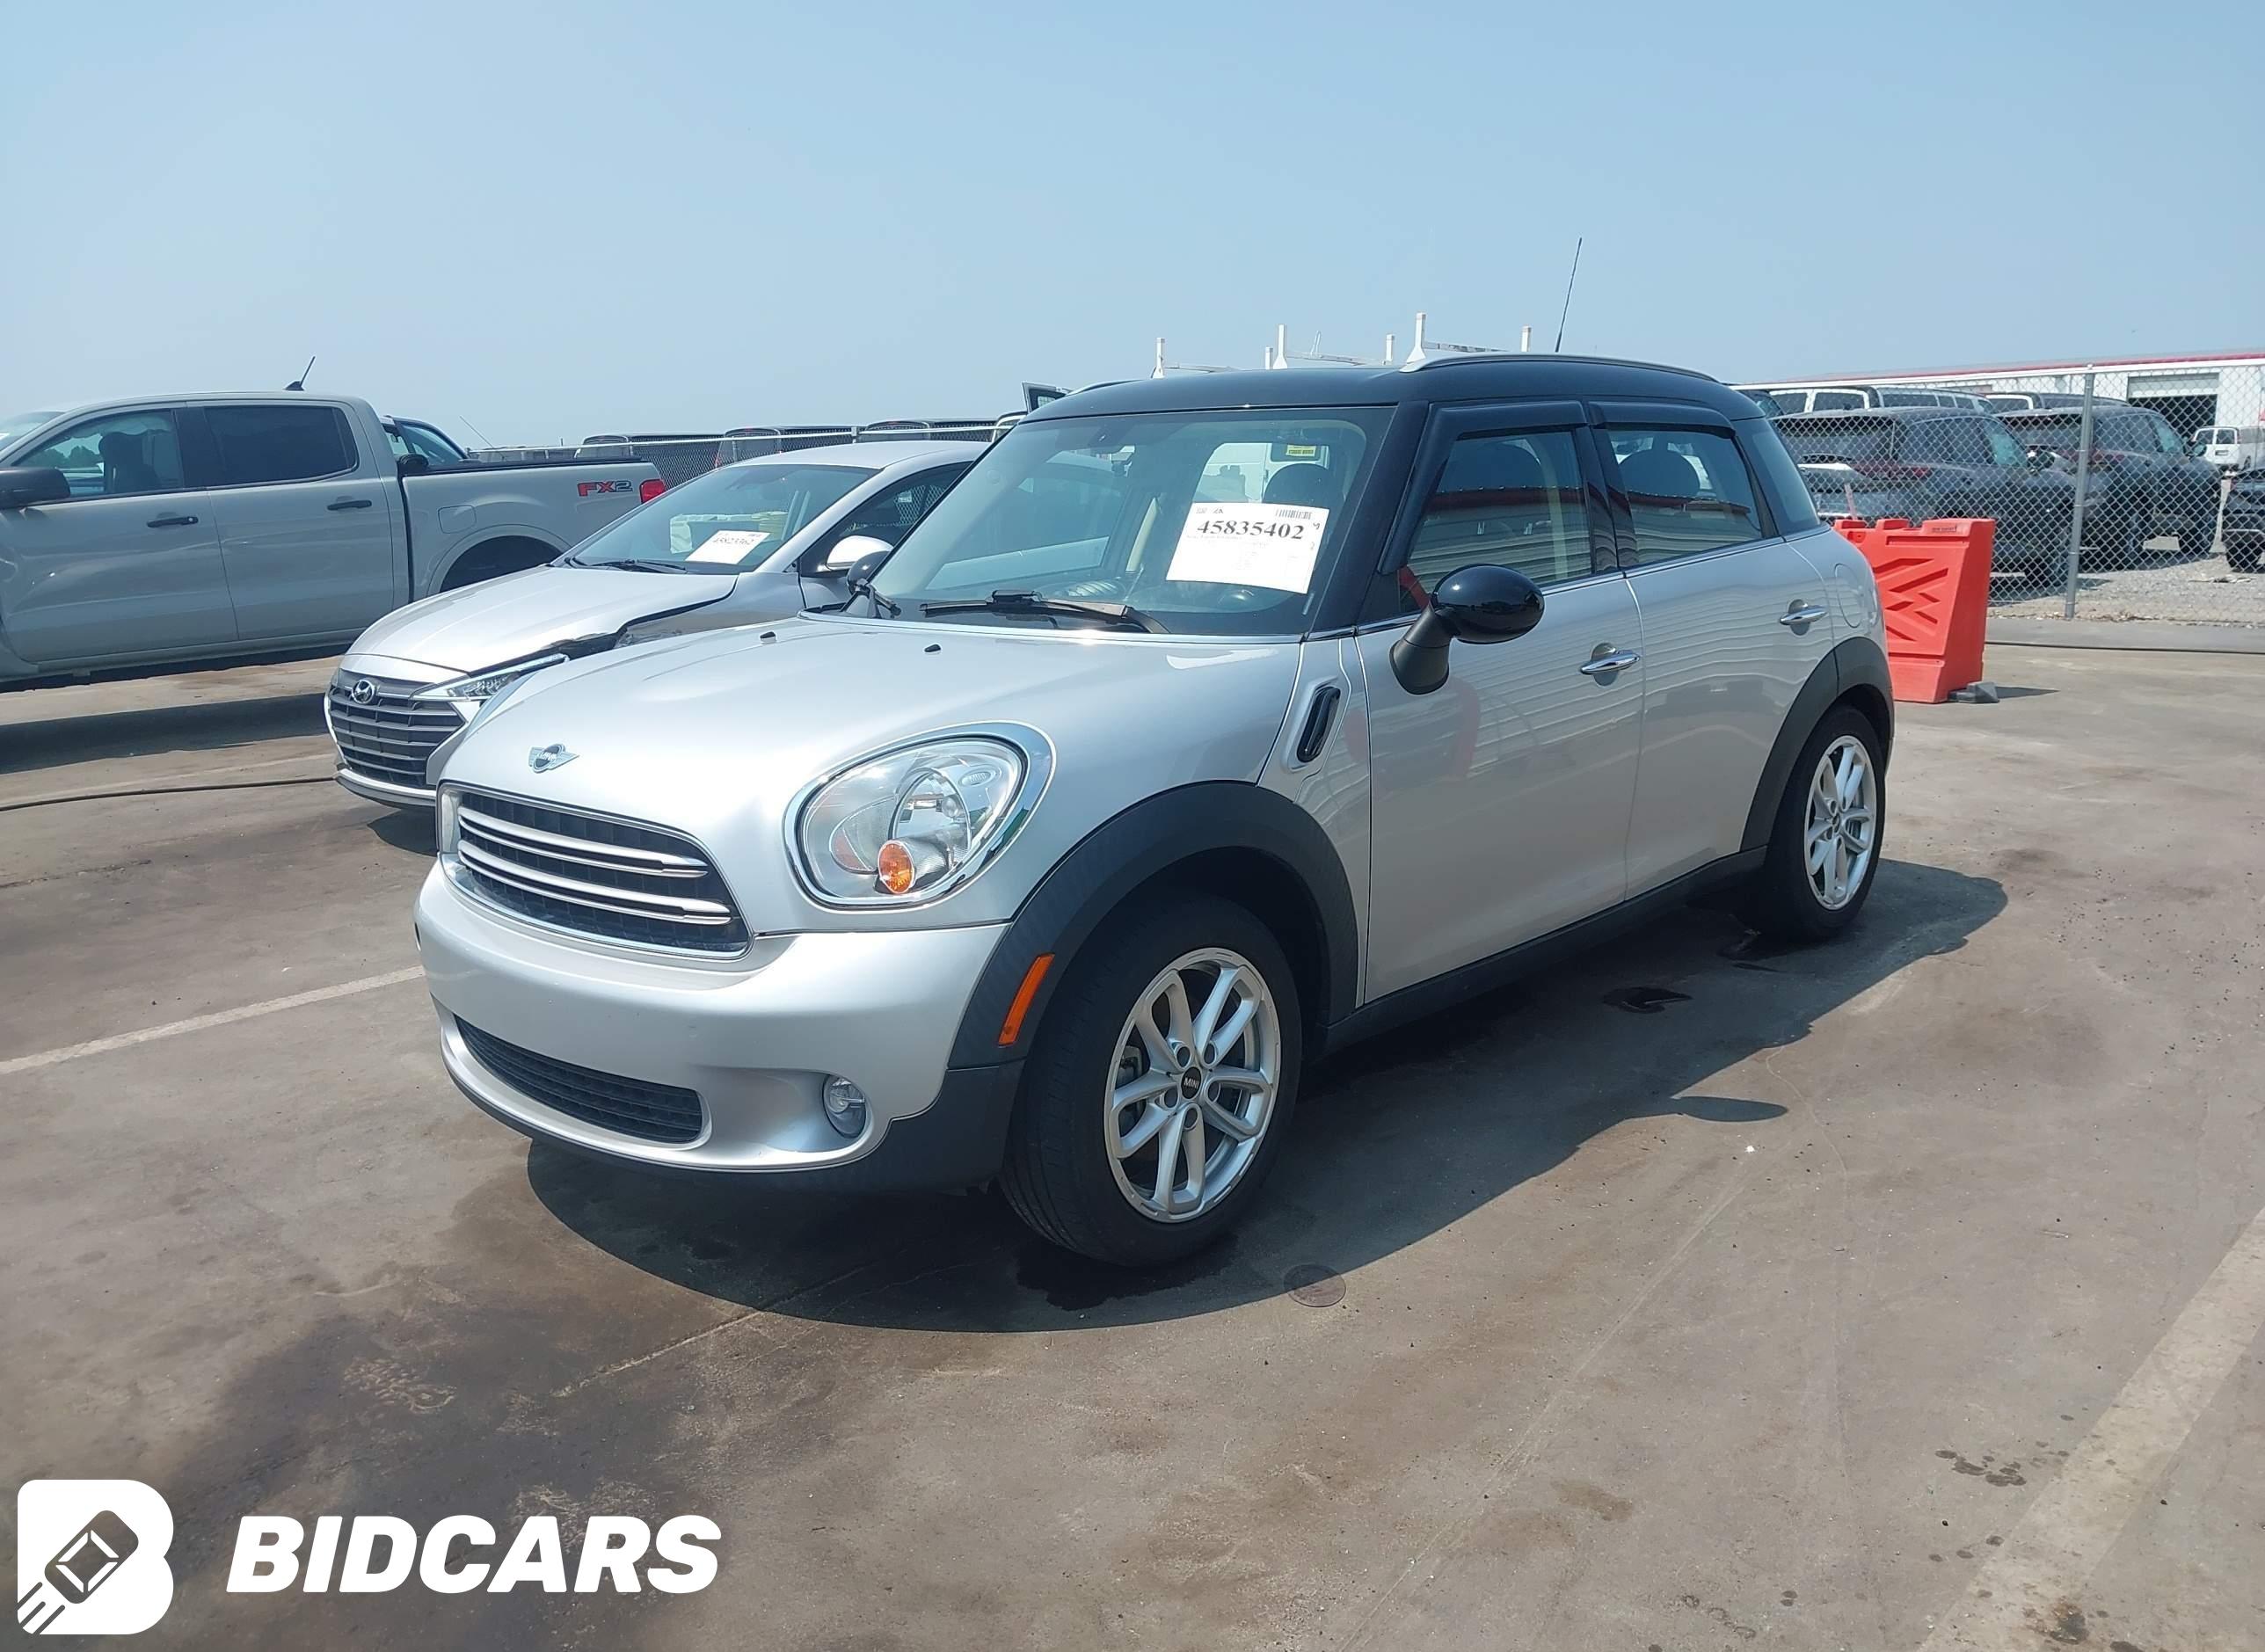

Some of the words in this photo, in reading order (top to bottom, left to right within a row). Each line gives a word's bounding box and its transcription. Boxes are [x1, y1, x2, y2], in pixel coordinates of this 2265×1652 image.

[577, 480, 633, 497] FX2
[1197, 520, 1305, 540] 45835402
[1183, 1077, 1200, 1089] MINI
